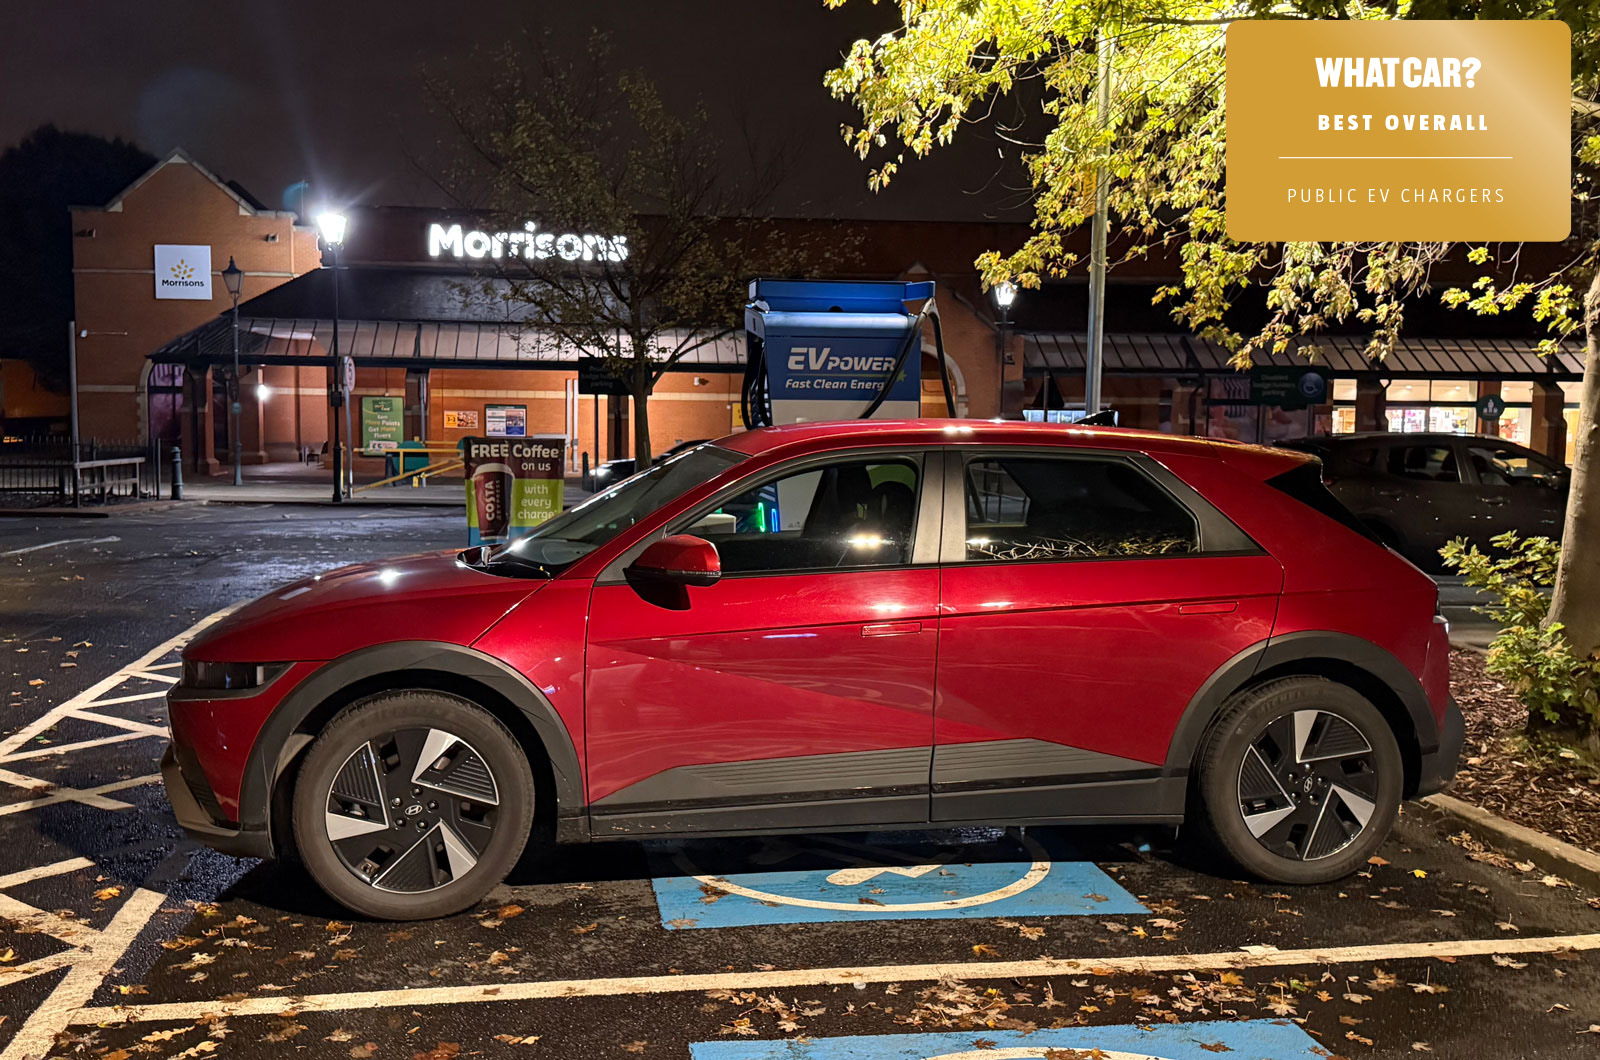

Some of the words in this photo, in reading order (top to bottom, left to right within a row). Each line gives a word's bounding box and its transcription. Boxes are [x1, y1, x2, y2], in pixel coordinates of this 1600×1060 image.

[429, 221, 629, 262] Morrisons
[161, 276, 205, 287] Morrisons
[785, 379, 811, 389] Fast
[813, 379, 847, 389] Clean
[850, 379, 888, 391] Energ
[471, 444, 509, 458] FREE
[521, 463, 535, 471] on
[538, 463, 551, 471] us
[524, 484, 548, 495] with
[485, 481, 495, 521] COSTA
[521, 498, 552, 509] every
